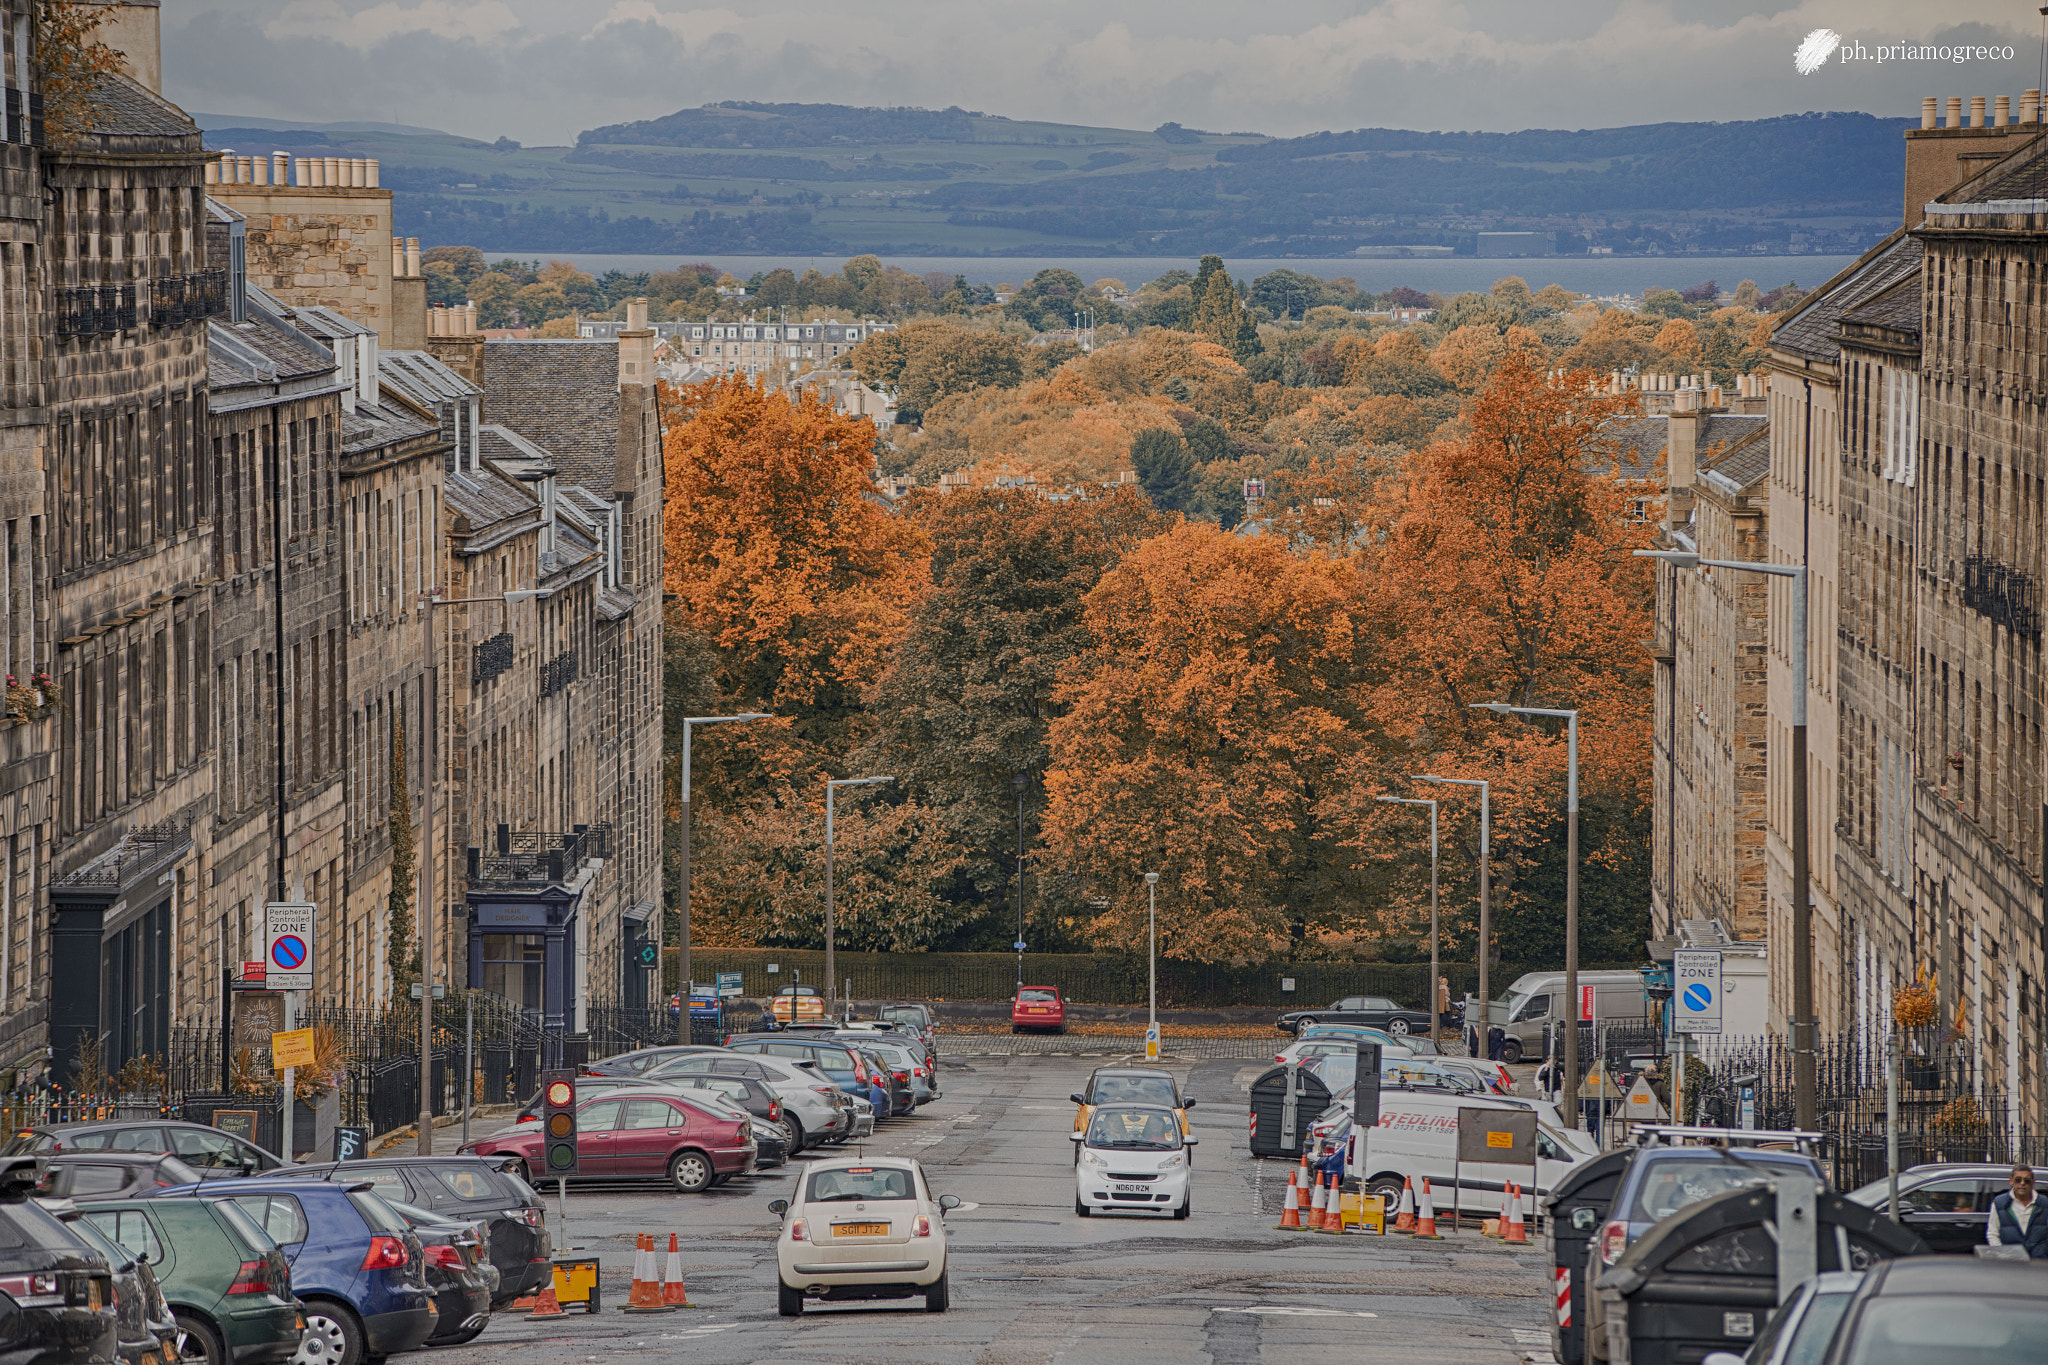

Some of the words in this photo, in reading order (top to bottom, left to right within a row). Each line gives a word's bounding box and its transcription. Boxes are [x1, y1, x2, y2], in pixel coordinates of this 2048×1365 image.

[269, 908, 309, 917] Peripheral
[272, 923, 307, 932] ZONE
[1678, 953, 1718, 962] Peripheral
[1680, 968, 1715, 977] ZONE
[1375, 1111, 1458, 1129] REDLINE
[1393, 1123, 1415, 1131] 0131
[841, 1226, 859, 1235] SG11
[862, 1225, 880, 1233] JTZ
